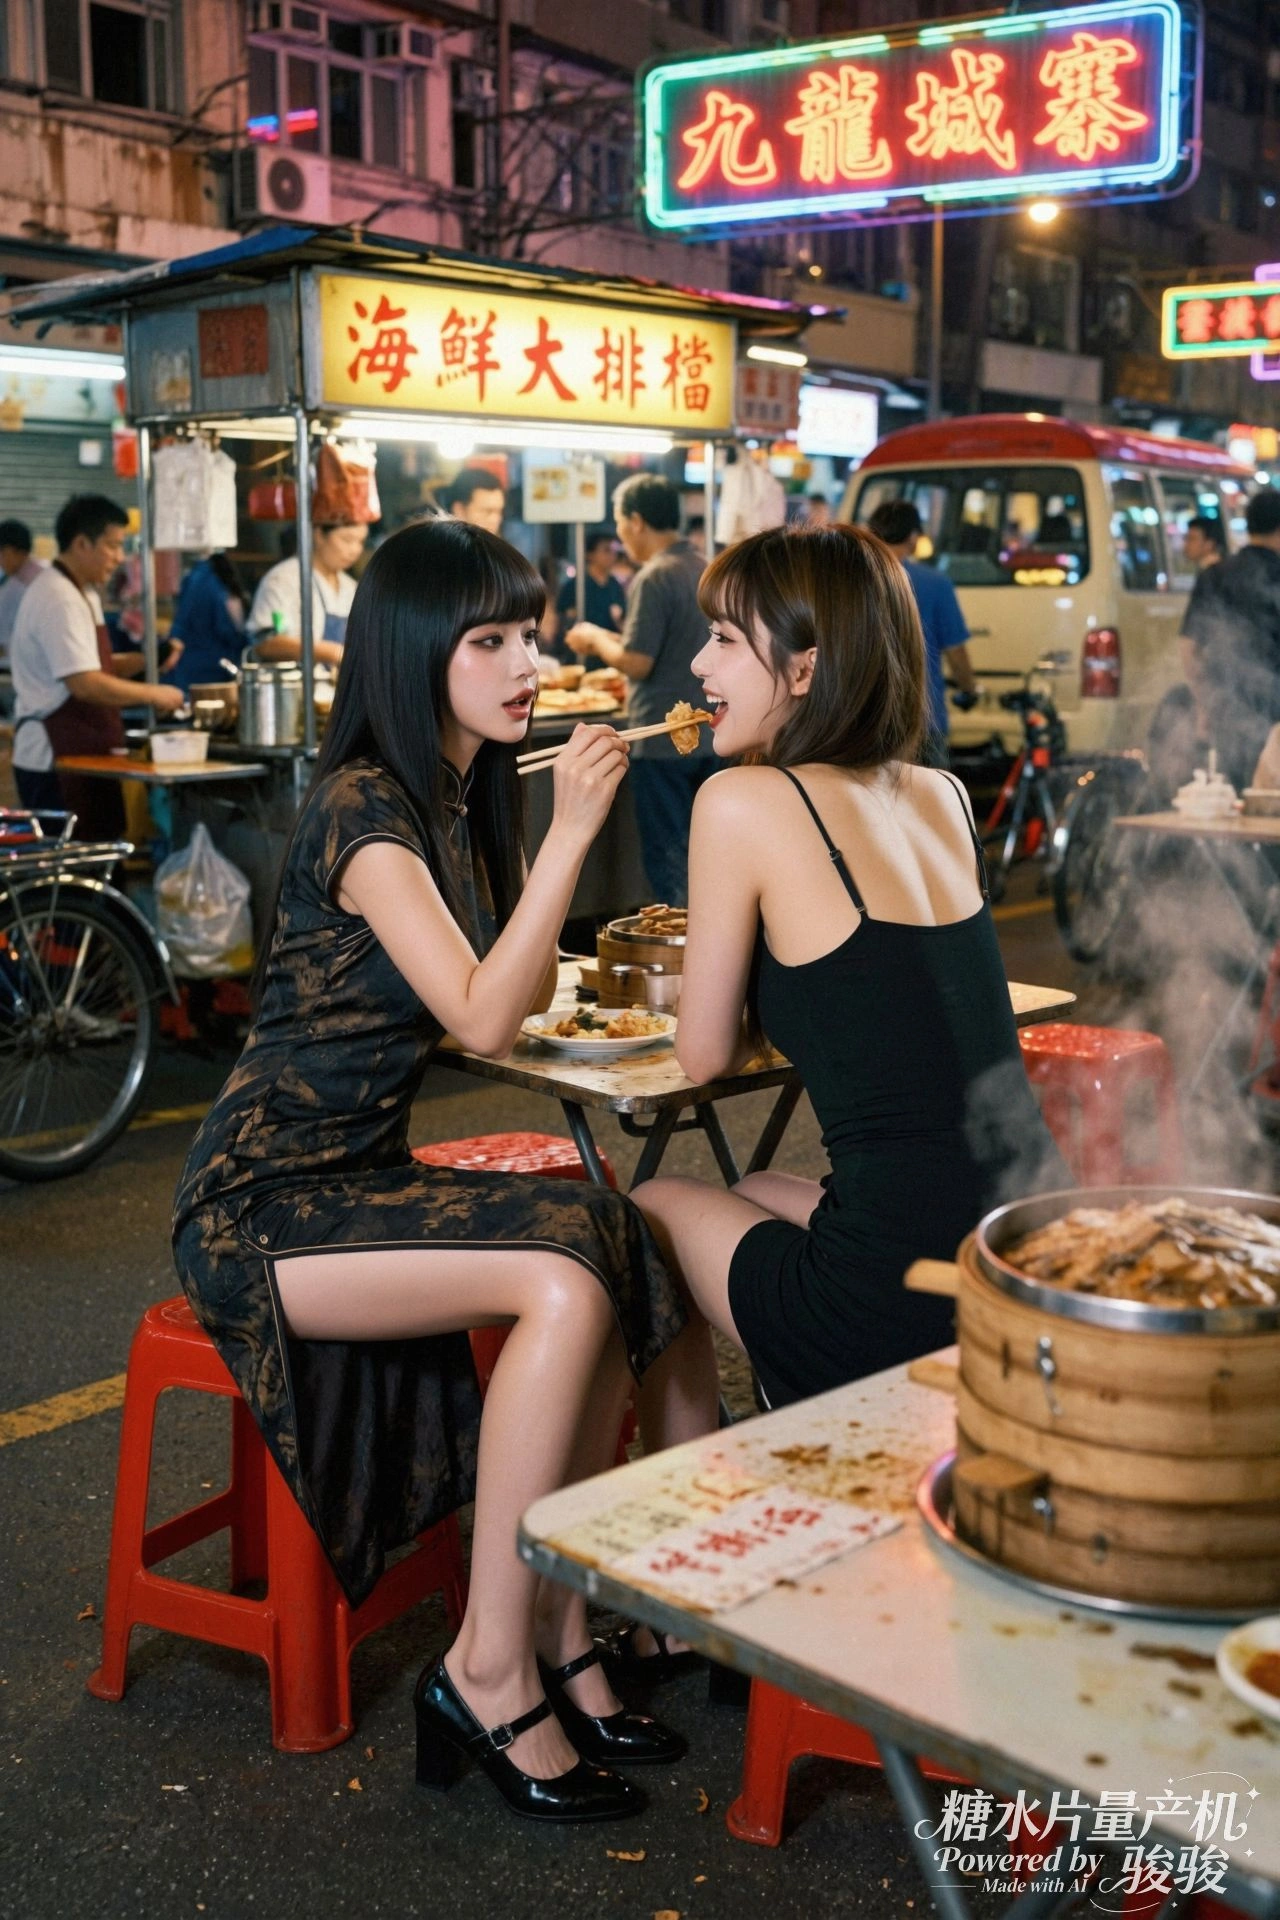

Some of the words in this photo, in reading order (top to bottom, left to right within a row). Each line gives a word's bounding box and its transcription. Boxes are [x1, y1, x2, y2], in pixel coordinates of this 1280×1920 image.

[677, 31, 1150, 191] 九龍城寨
[346, 294, 717, 413] 海鮮大排檔
